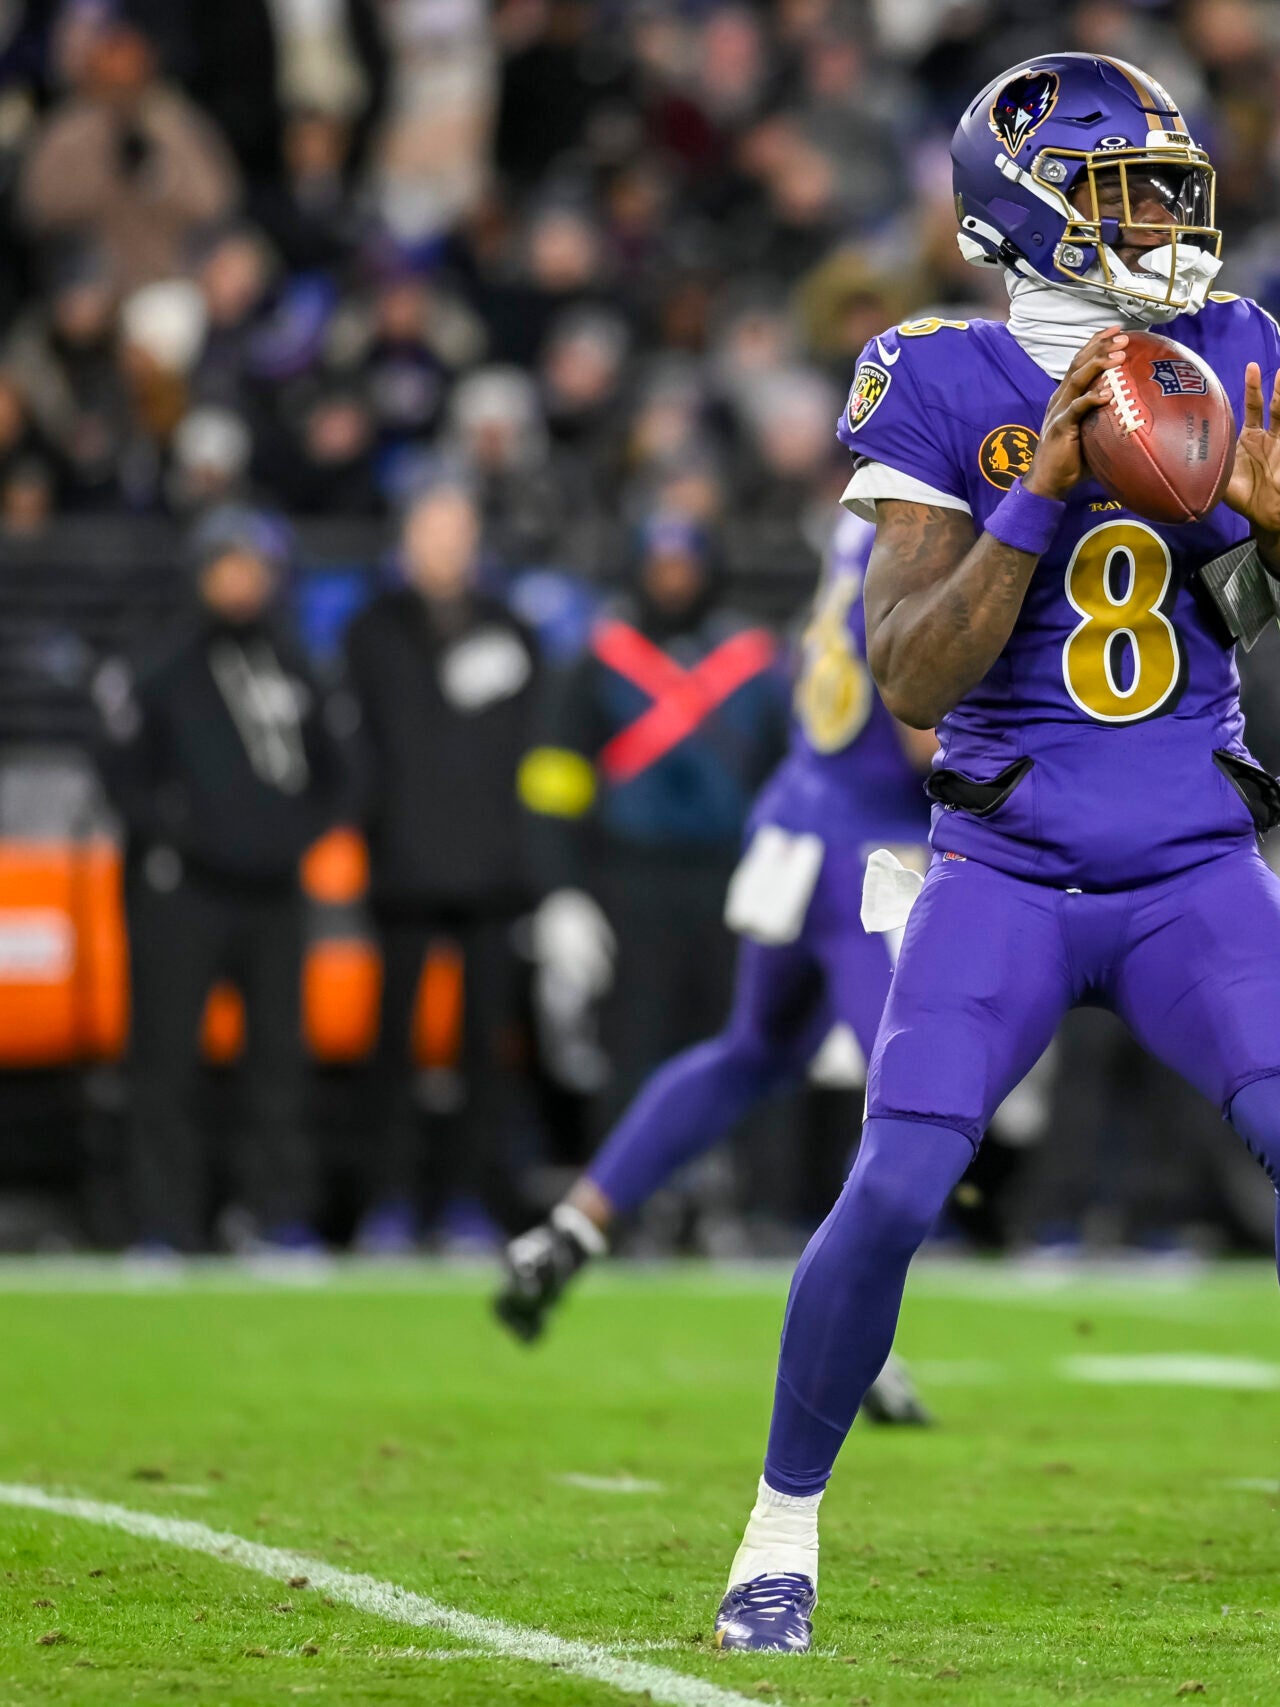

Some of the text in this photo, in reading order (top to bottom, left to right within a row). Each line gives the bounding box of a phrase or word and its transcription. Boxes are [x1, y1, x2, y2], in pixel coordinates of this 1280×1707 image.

[1174, 362, 1203, 391] NFL
[1089, 501, 1122, 512] RAV
[1062, 519, 1188, 727] 8
